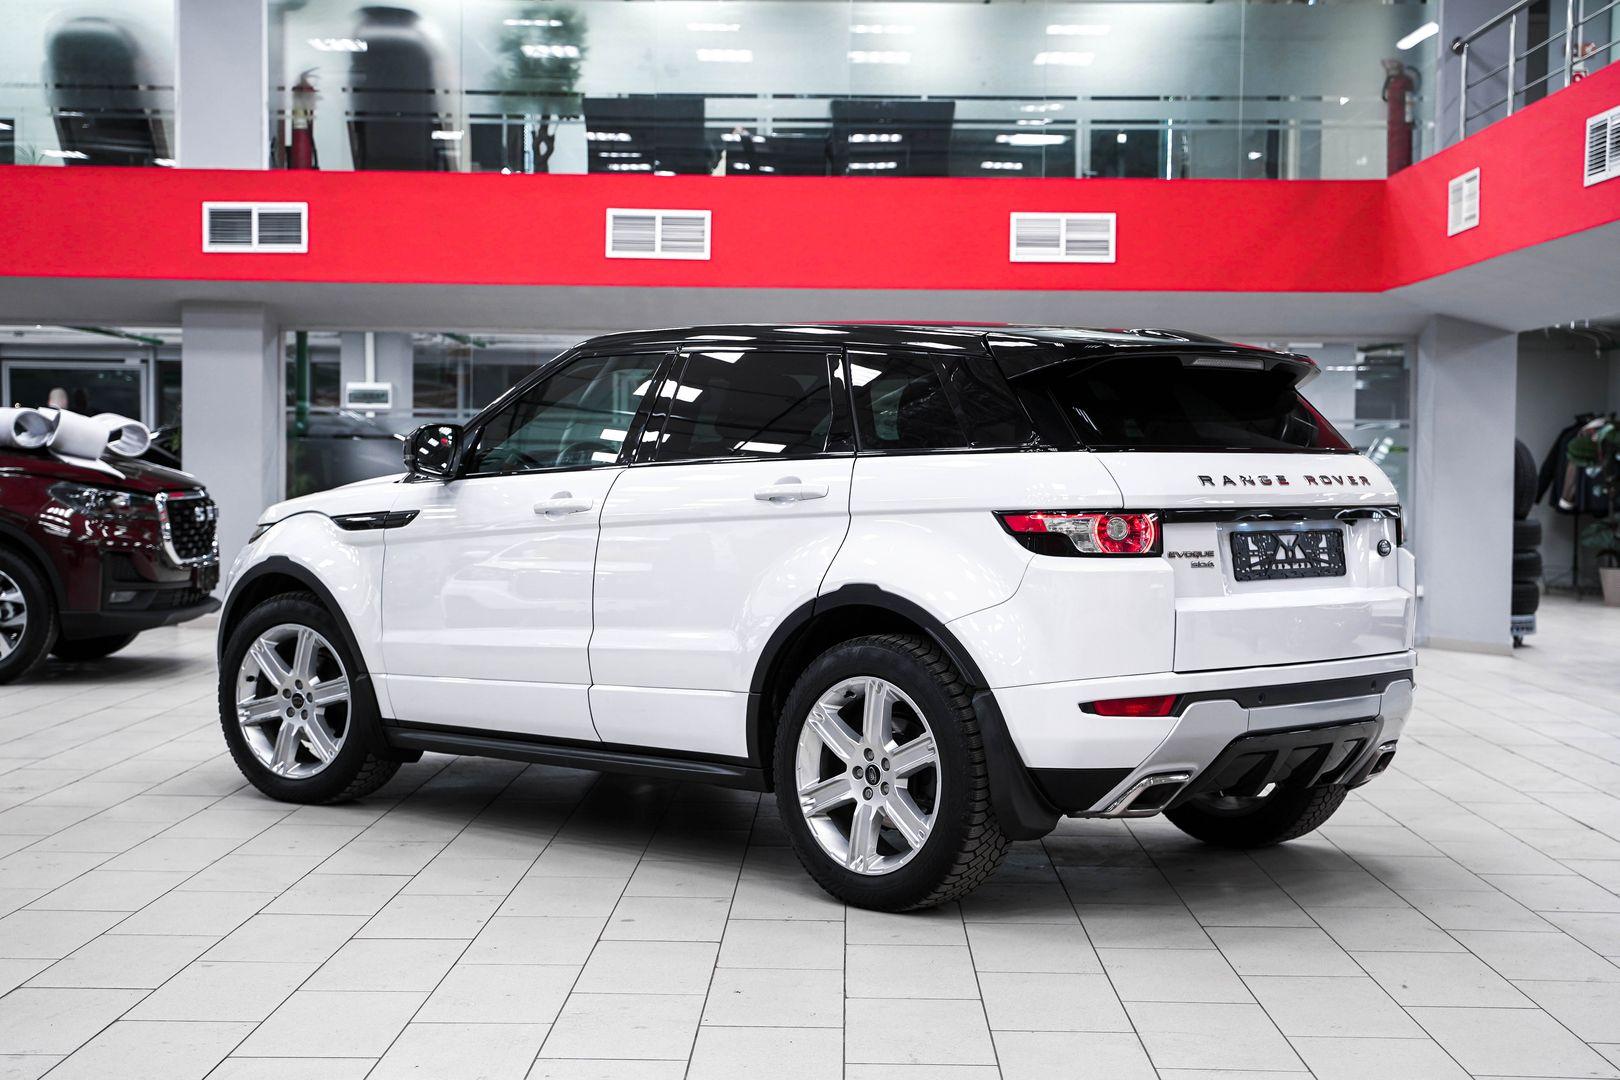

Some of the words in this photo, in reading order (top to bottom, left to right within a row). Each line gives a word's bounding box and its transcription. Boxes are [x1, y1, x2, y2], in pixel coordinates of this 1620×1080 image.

[1197, 474, 1290, 487] RANGE
[1302, 474, 1371, 487] ROVER
[1166, 550, 1215, 559] EVOQUE
